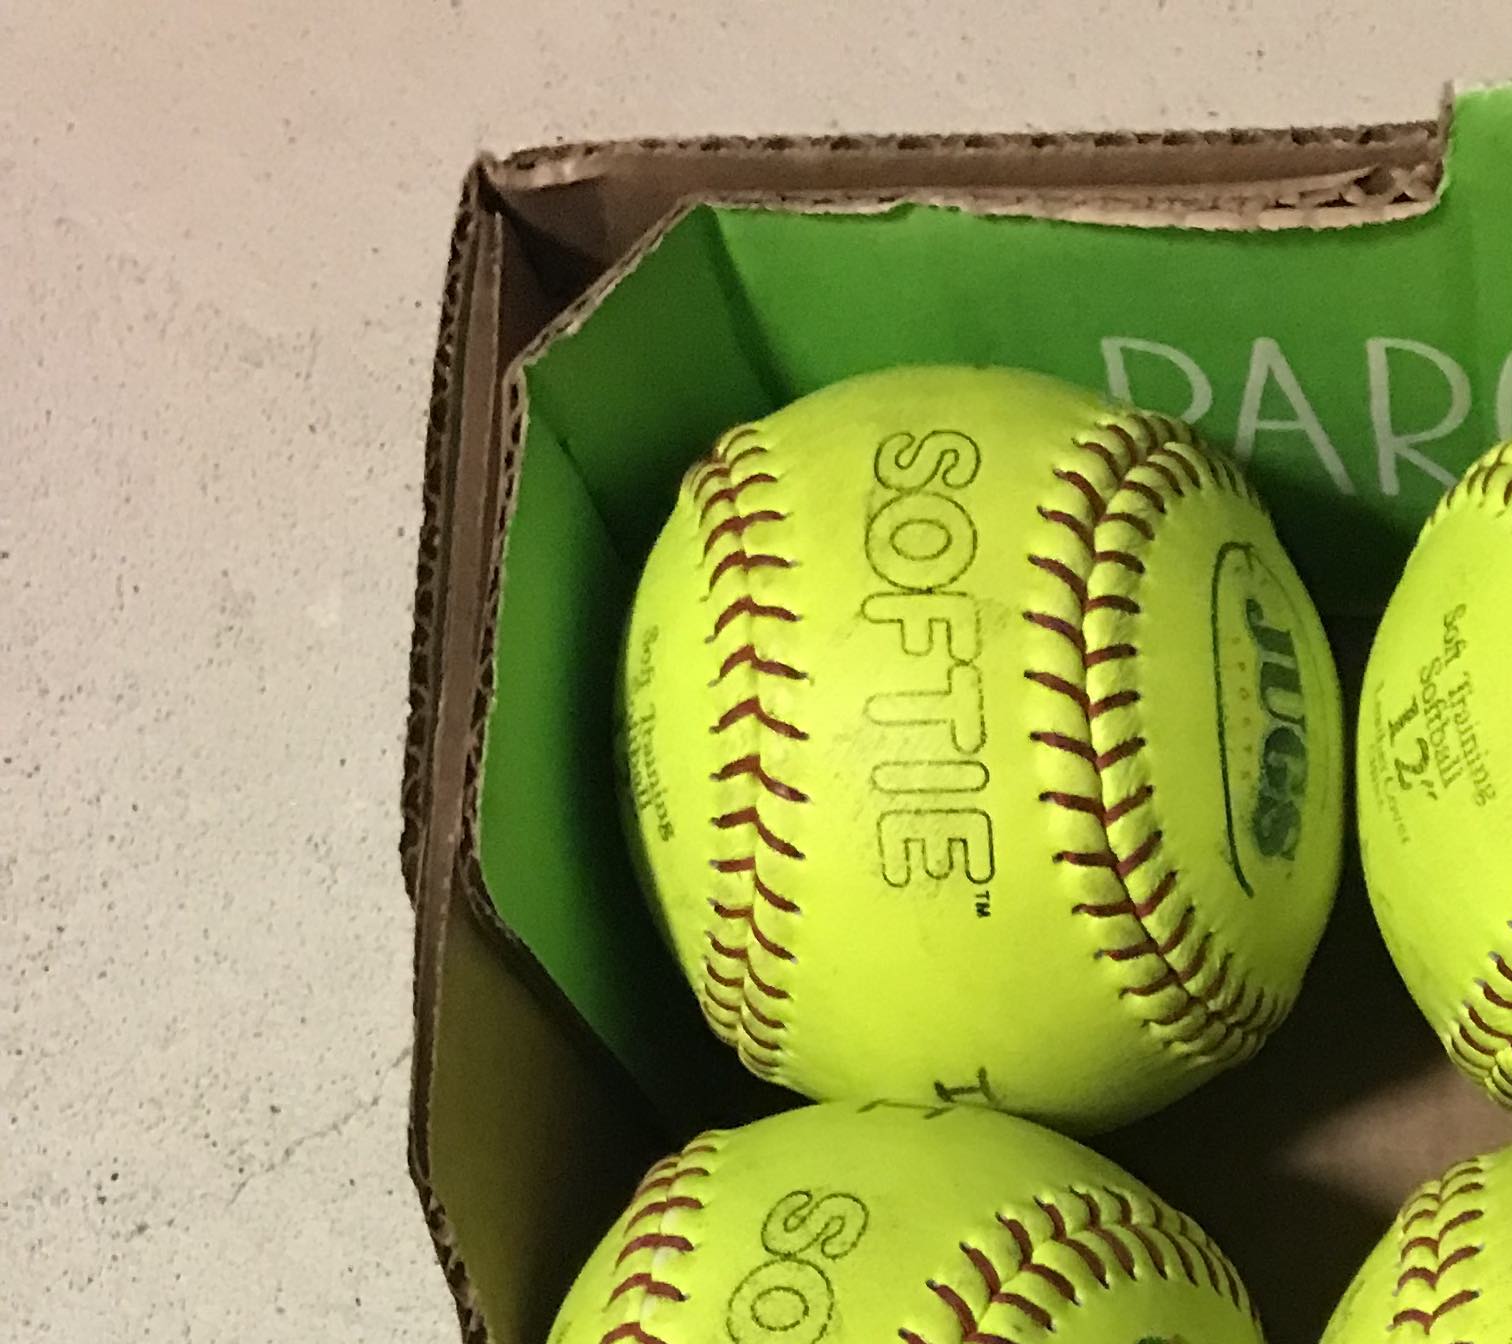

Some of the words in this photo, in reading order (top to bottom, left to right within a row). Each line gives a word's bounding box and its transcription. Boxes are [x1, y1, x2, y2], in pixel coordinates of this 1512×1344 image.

[862, 429, 996, 888] SOFTIE
[1246, 597, 1316, 862] JUGS
[1420, 655, 1464, 791] Softball
[1448, 670, 1498, 808] Training
